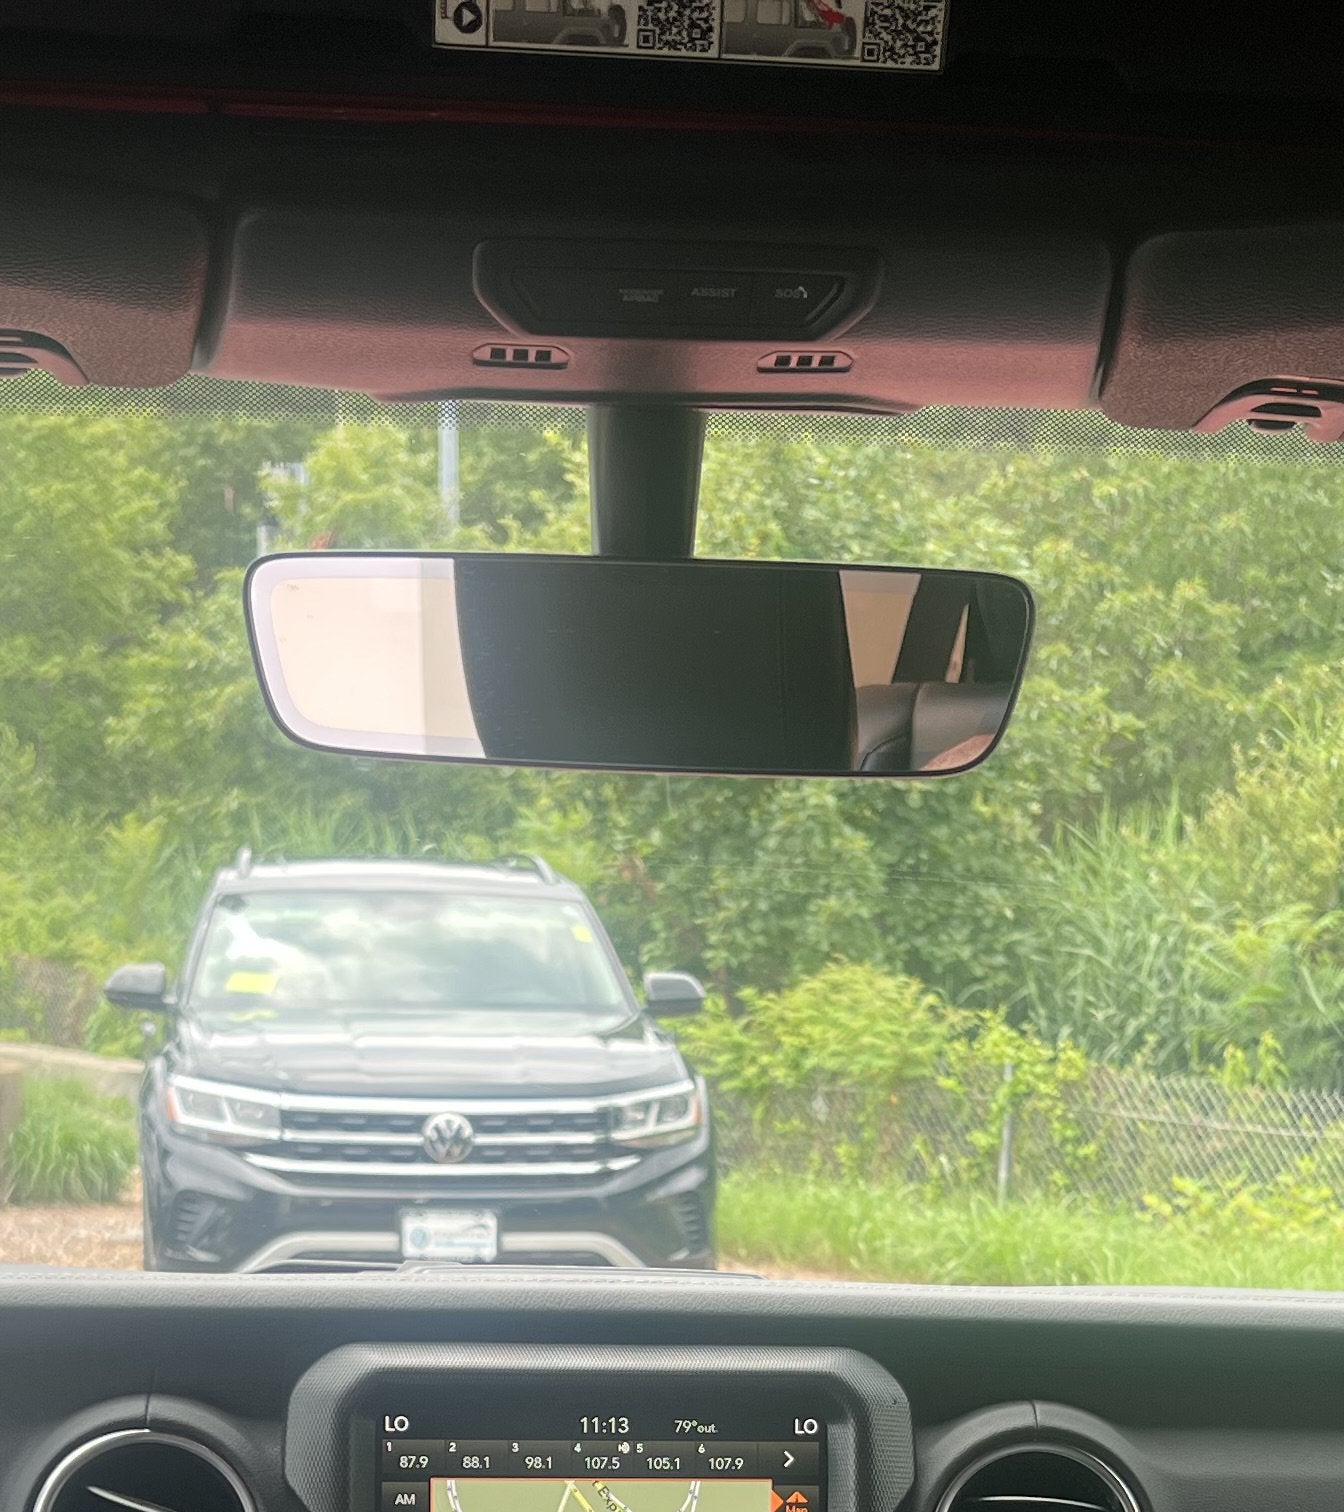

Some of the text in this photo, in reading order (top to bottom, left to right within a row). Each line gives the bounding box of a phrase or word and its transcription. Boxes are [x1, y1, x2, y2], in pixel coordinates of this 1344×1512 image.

[384, 1415, 409, 1432] LO
[580, 1416, 630, 1434] 11:13
[794, 1418, 818, 1434] LO
[386, 1442, 392, 1452] 1
[449, 1442, 457, 1452] 2
[511, 1442, 519, 1452] 3
[573, 1443, 582, 1452] 4
[636, 1443, 644, 1453] 5
[698, 1444, 705, 1453] 6
[399, 1456, 429, 1469] 87.9
[462, 1456, 491, 1469] 88.1
[524, 1456, 552, 1469] 98.1
[584, 1456, 621, 1470] 107.5
[646, 1457, 681, 1470] 105.1
[708, 1457, 744, 1470] 107.9
[394, 1493, 416, 1506] AM
